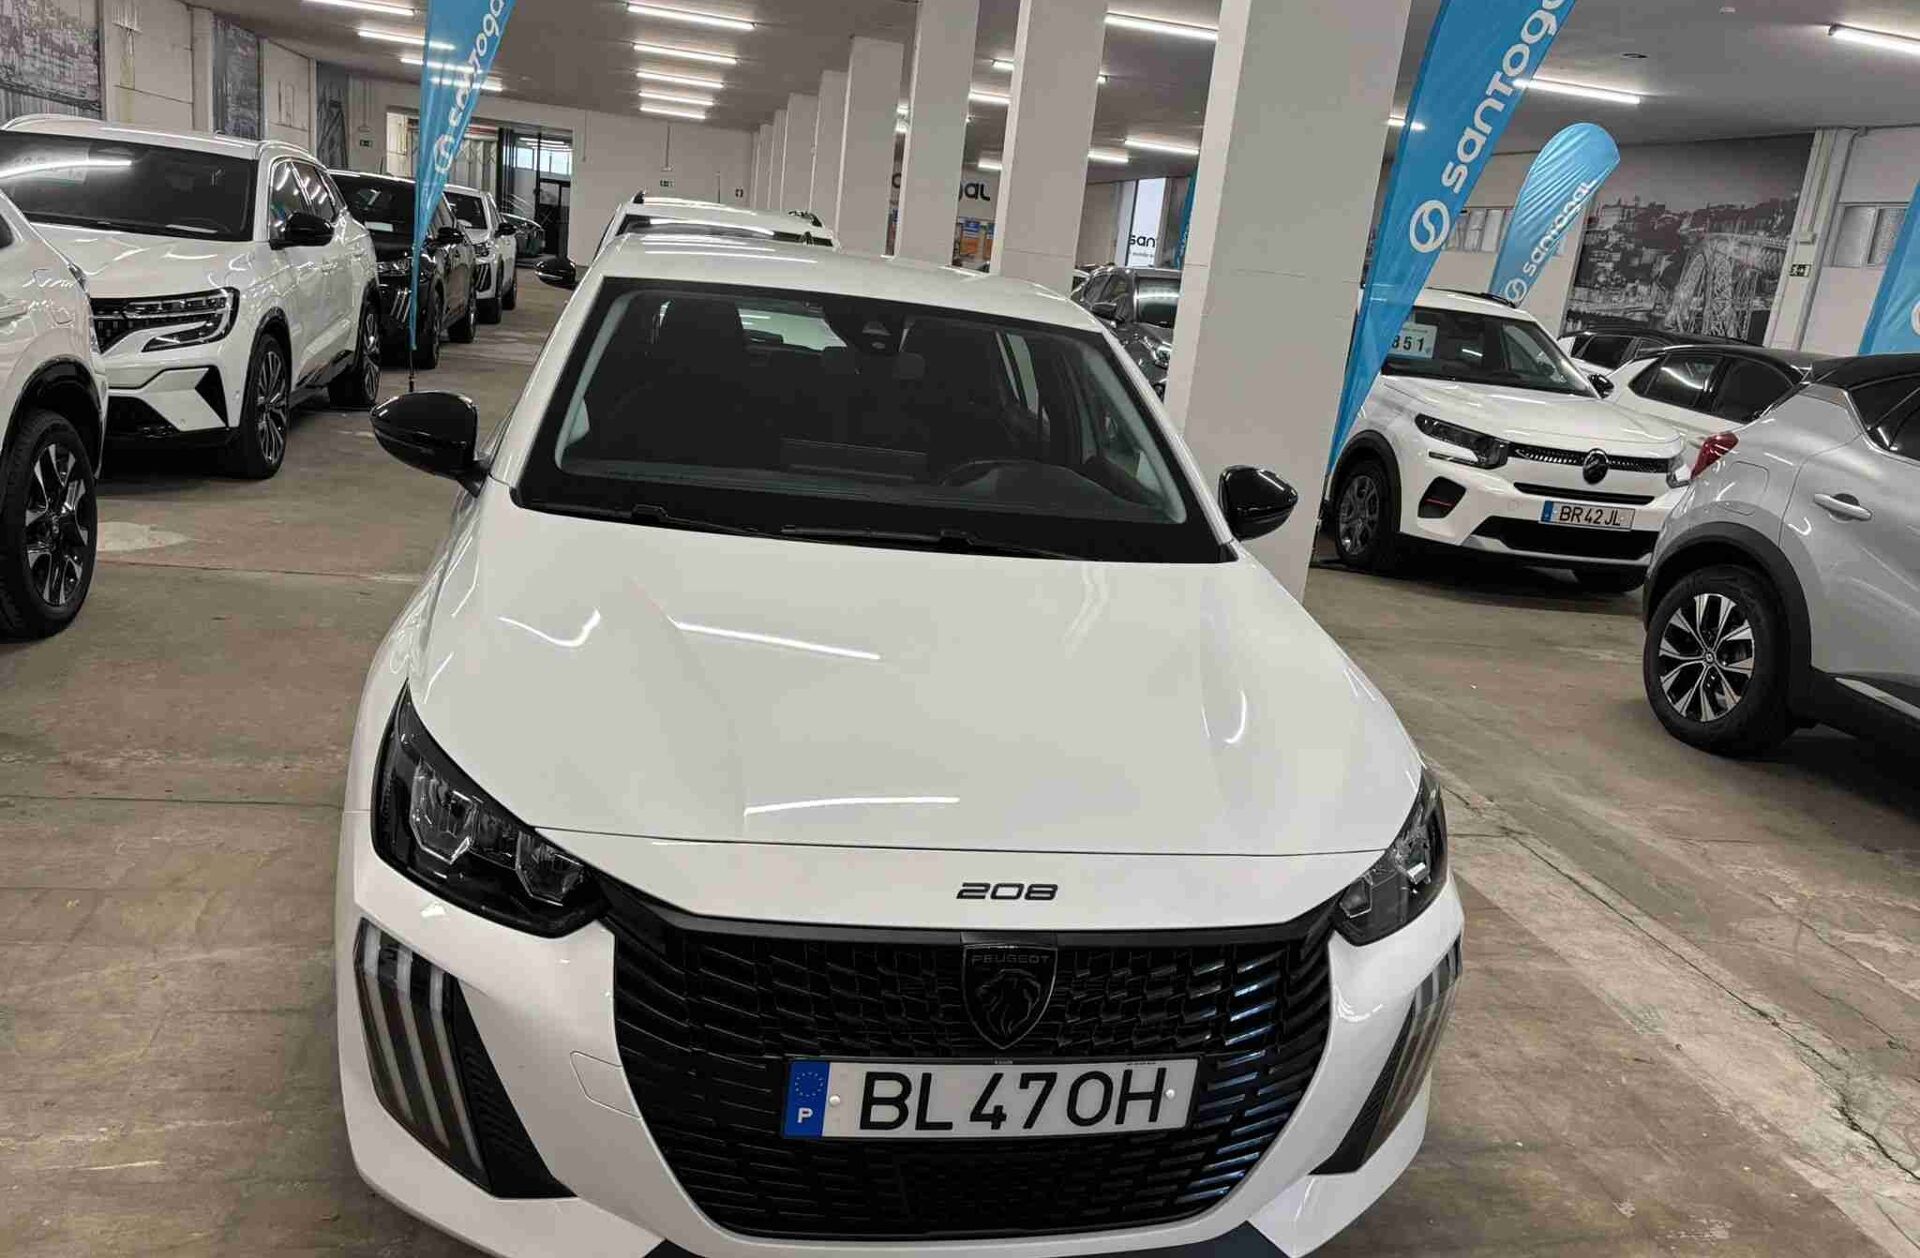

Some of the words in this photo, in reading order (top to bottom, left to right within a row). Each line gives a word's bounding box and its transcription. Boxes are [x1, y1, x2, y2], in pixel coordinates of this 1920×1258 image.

[1441, 0, 1565, 194] santog
[1559, 505, 1583, 523] BR
[1584, 508, 1604, 525] 42
[956, 882, 1059, 901] 208
[971, 953, 1050, 966] PEUGEOT
[858, 1071, 954, 1131] BL
